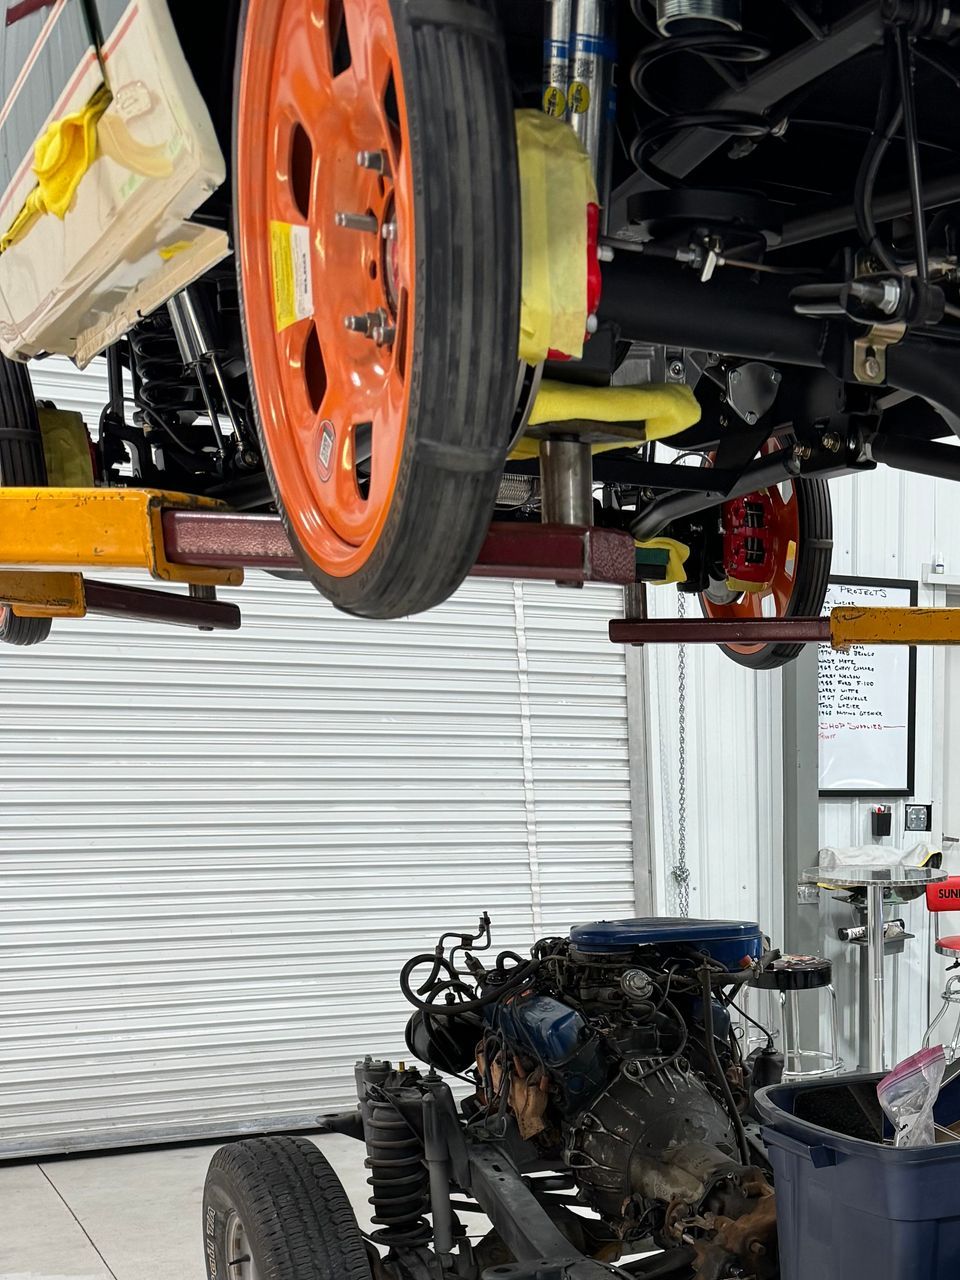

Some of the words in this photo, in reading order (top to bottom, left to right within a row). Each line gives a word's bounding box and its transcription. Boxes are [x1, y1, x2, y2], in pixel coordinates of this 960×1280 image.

[840, 585, 887, 598] PROJECTS
[820, 722, 845, 730] SHOP
[846, 722, 882, 730] SUPPLIES
[206, 1205, 216, 1237] T/A
